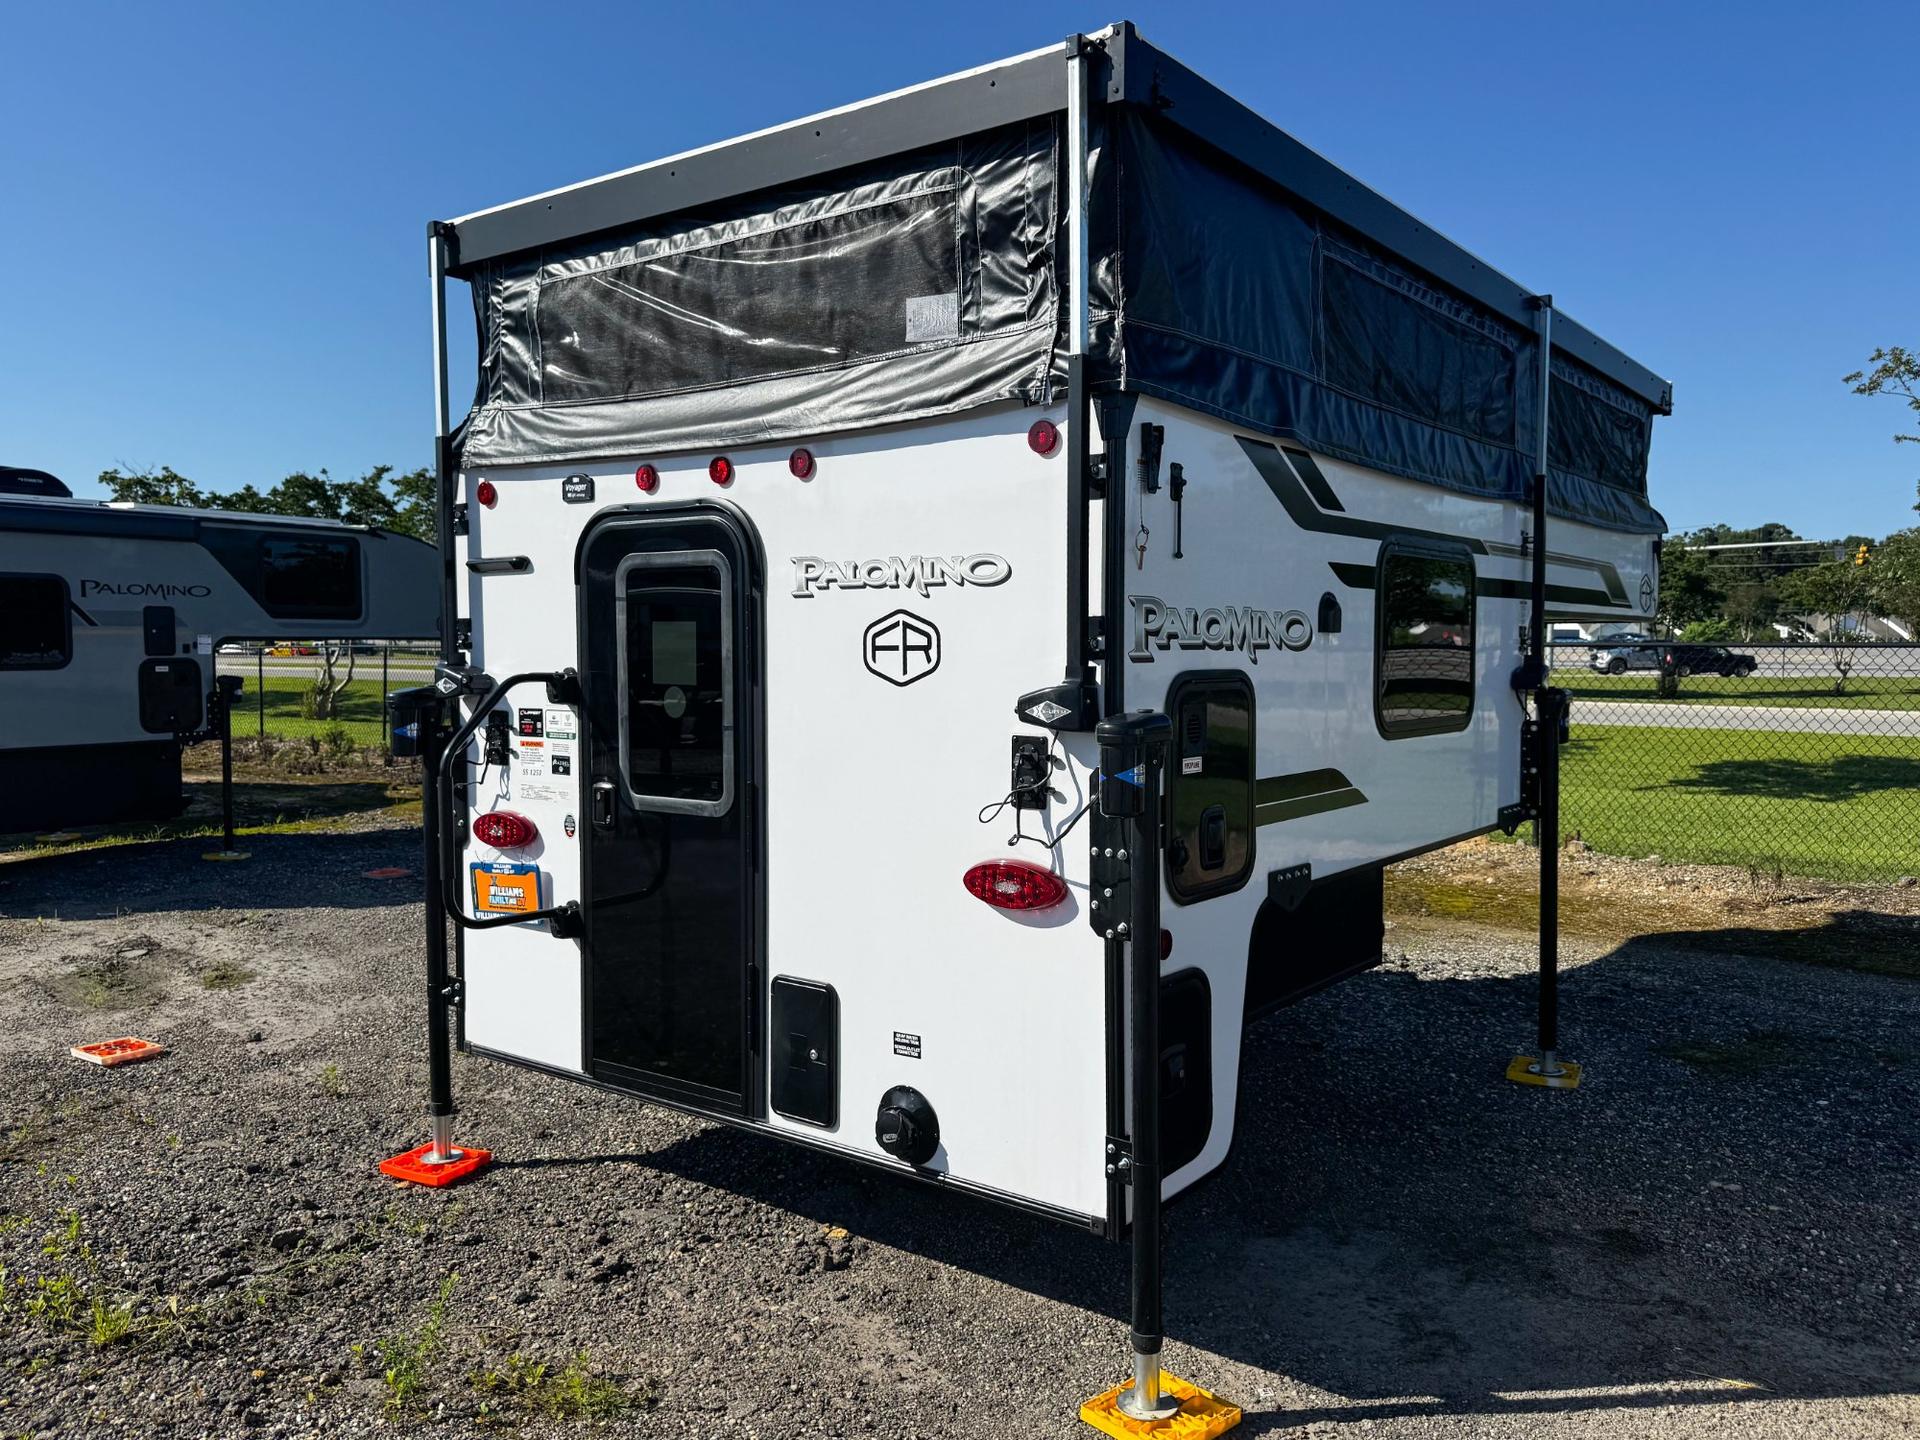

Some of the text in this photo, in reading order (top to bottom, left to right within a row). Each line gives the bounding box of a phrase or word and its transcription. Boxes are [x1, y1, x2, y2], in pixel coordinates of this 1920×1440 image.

[80, 579, 212, 601] PALOMINO
[791, 553, 1013, 599] PALOMINO
[1127, 595, 1313, 665] PALOMINO
[490, 885, 524, 897] WILLIAMS
